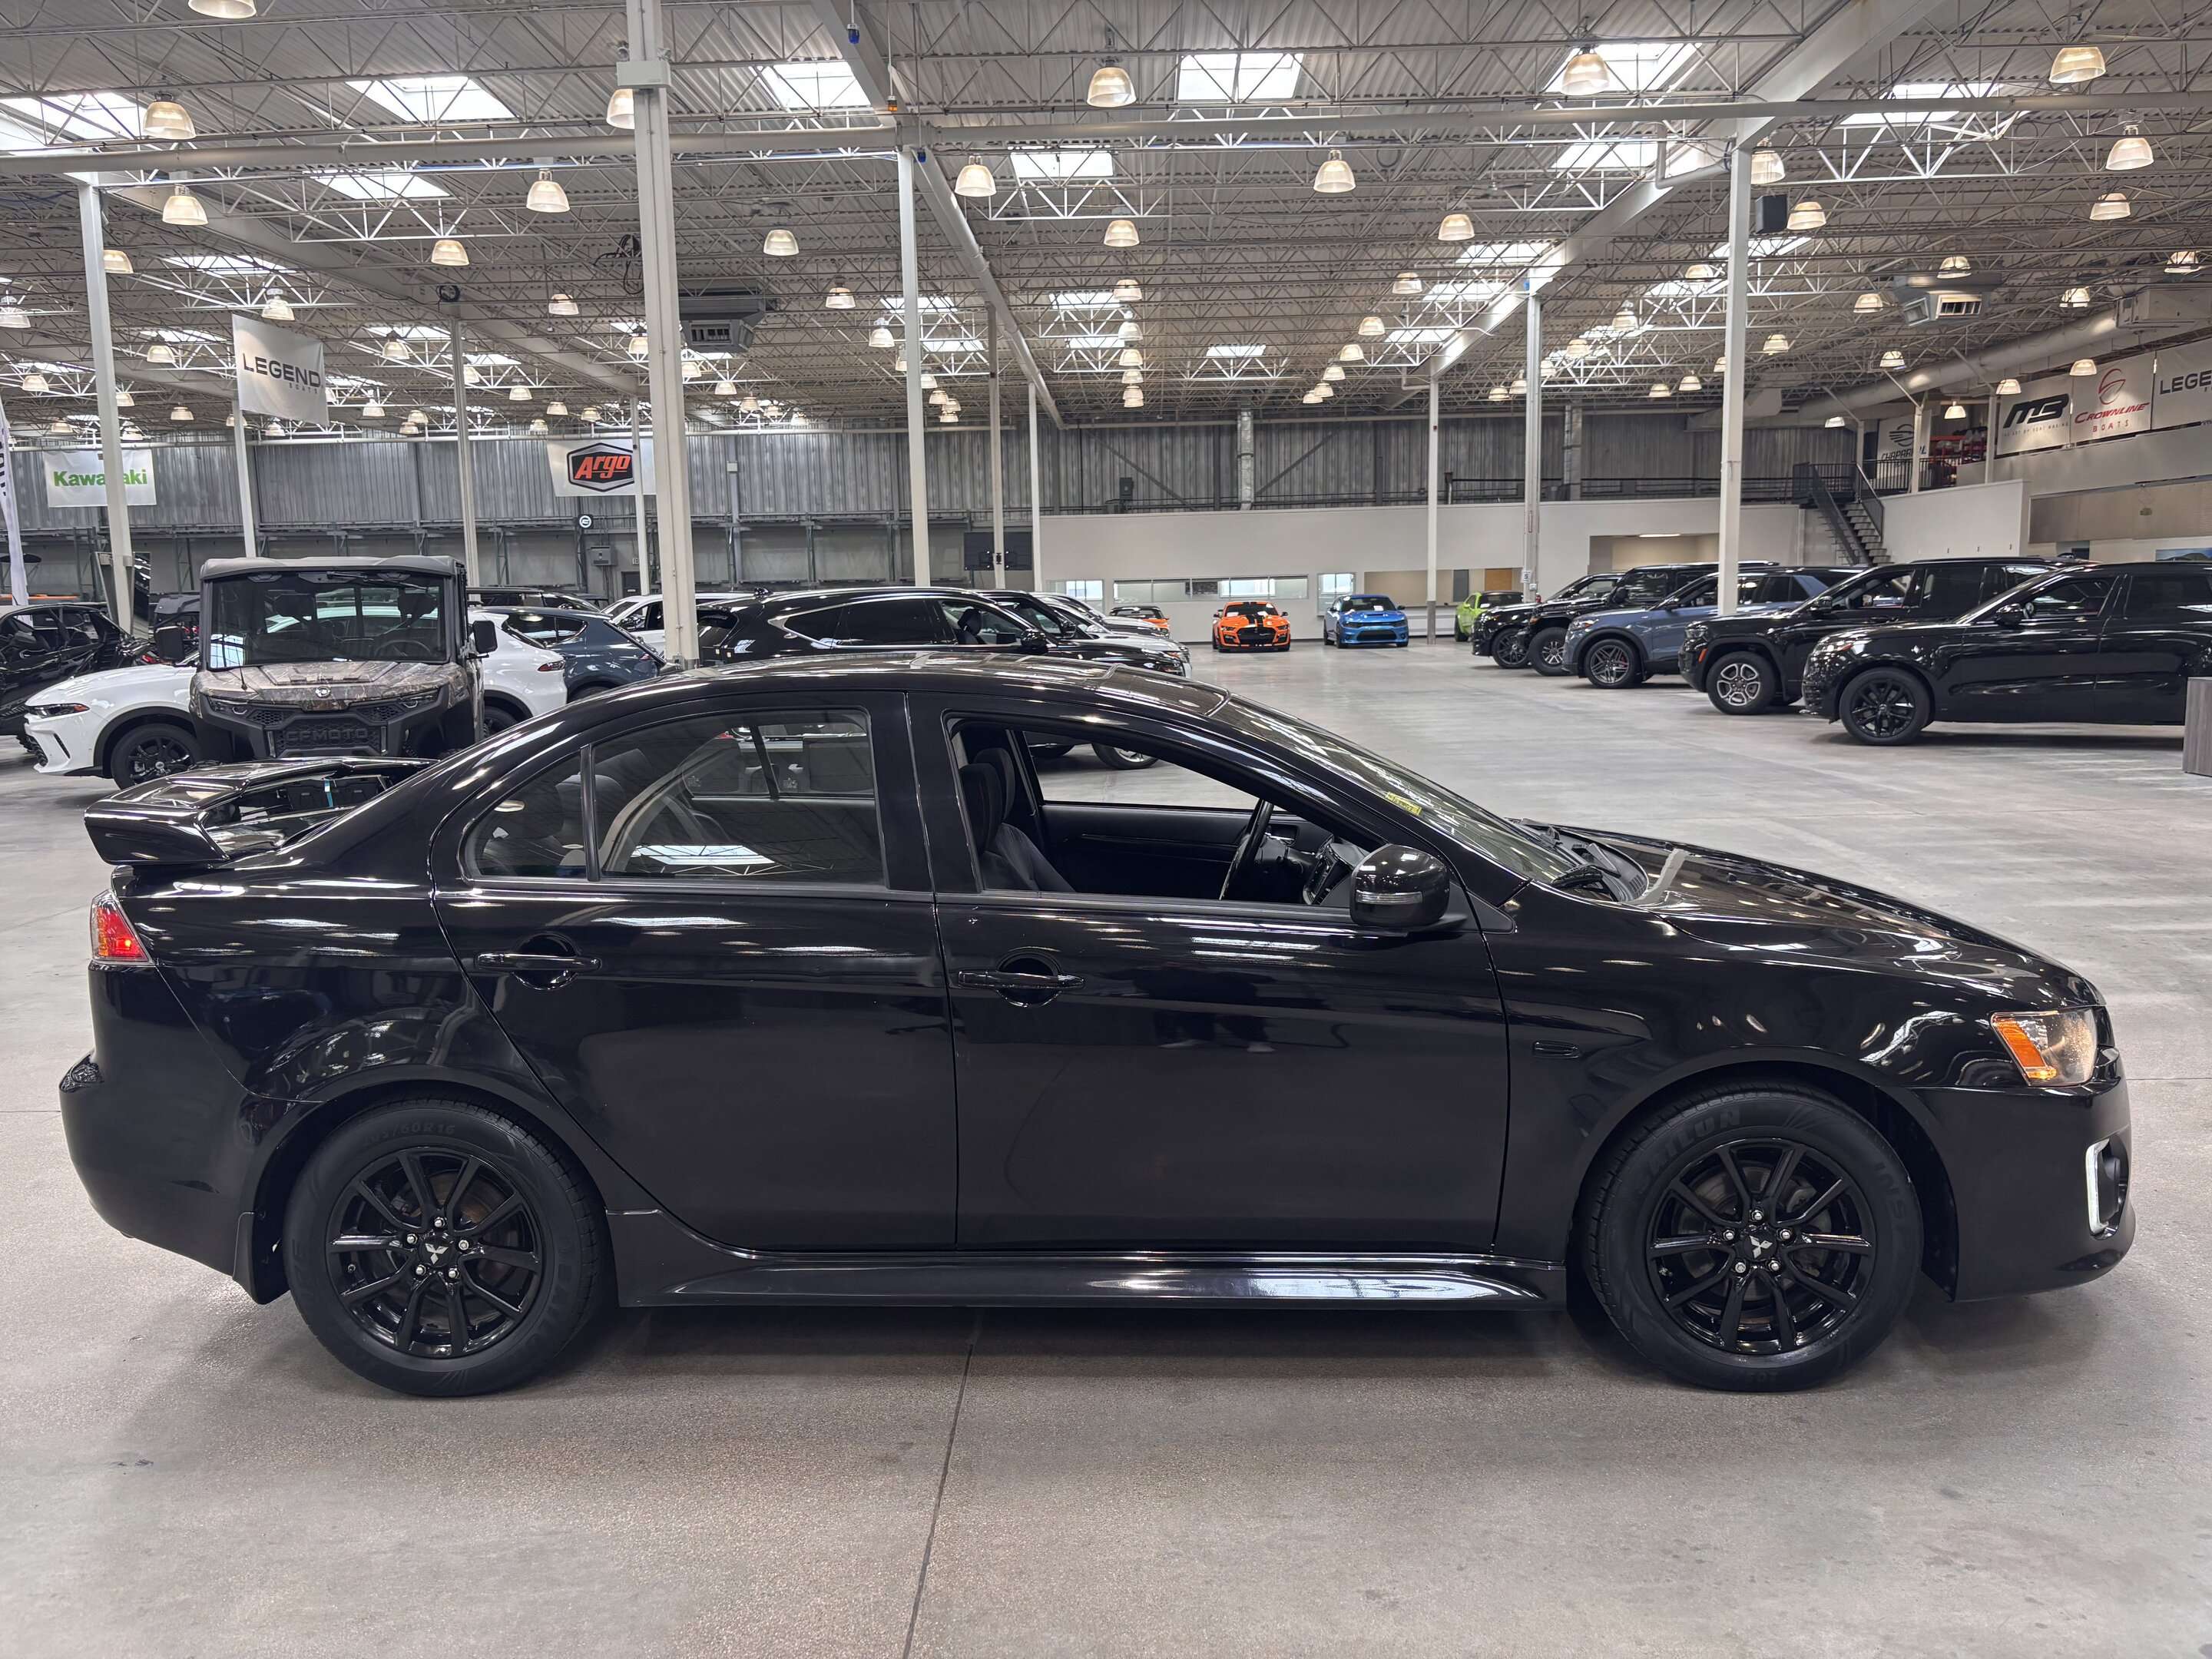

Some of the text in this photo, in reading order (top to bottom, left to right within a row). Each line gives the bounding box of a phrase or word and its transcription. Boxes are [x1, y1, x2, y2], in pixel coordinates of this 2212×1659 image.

[243, 353, 321, 387] LEGEND
[2075, 402, 2151, 424] CROWNLINE
[2092, 419, 2129, 432] BOATS
[1881, 445, 1927, 462] CHAPARL
[575, 455, 631, 479] Argo
[53, 469, 147, 486] Kawaaki
[285, 728, 369, 741] CFMOTO
